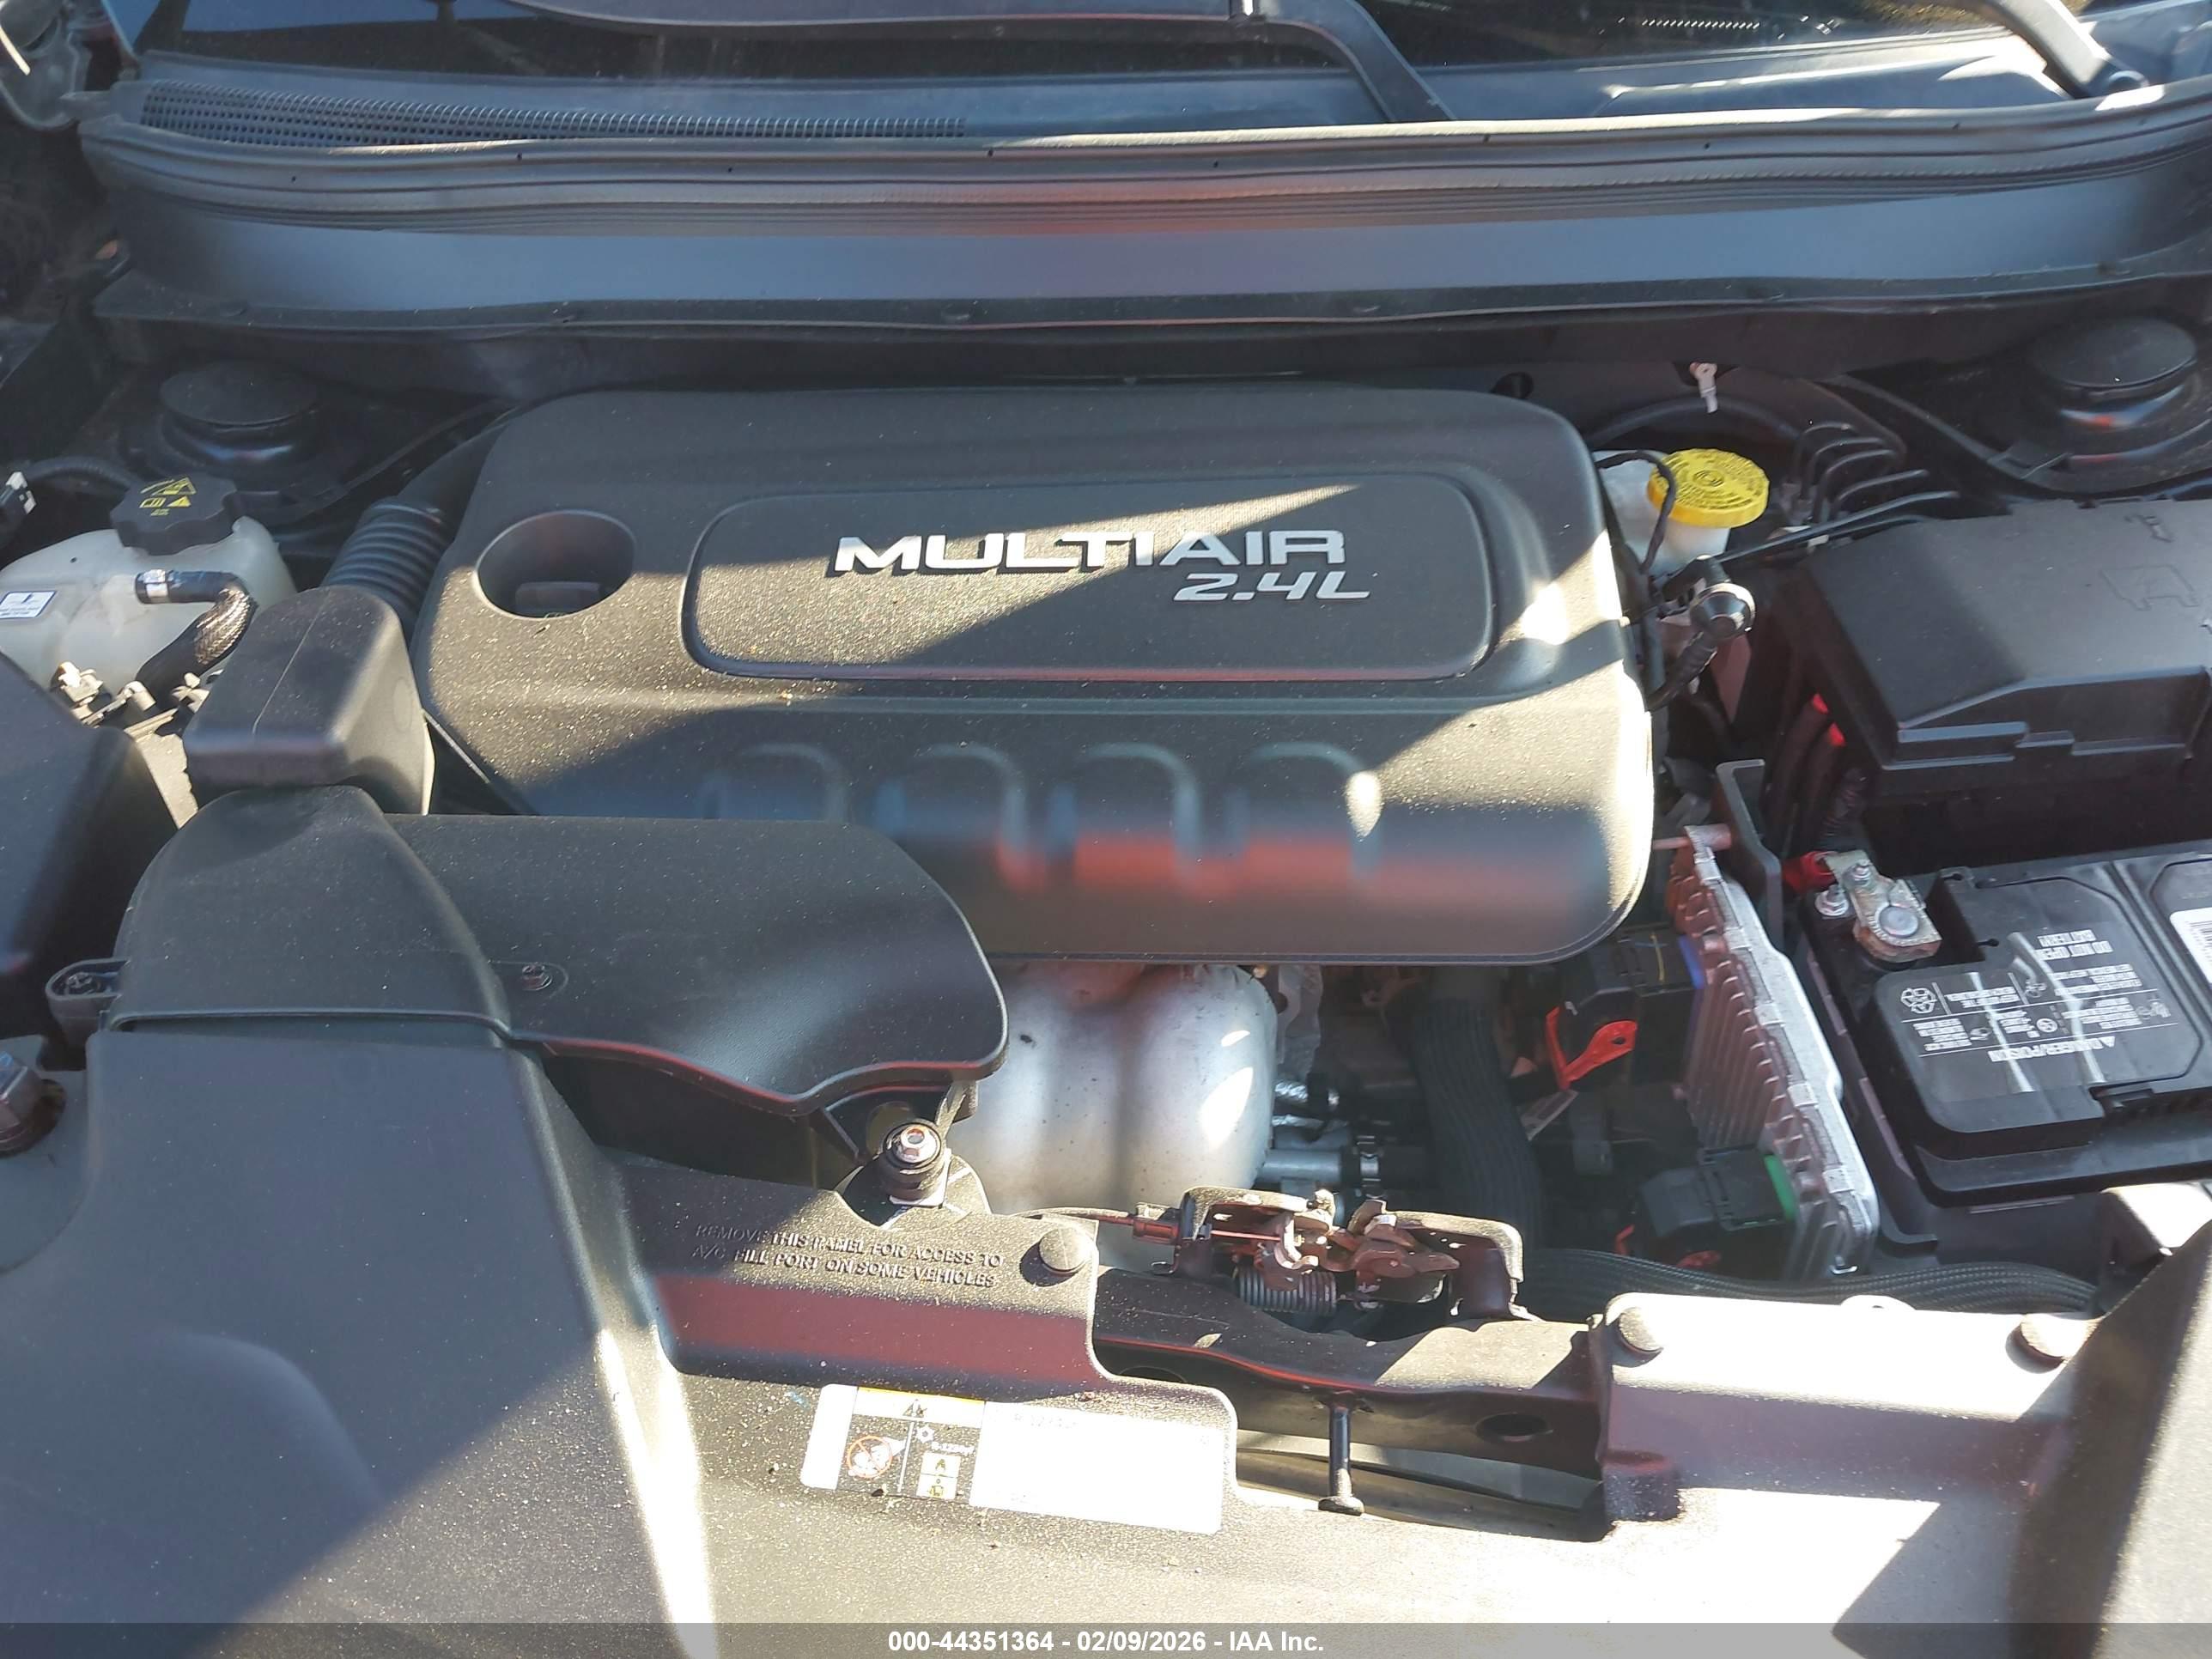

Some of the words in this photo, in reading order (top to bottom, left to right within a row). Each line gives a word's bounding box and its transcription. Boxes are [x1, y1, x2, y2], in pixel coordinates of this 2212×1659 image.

[833, 530, 1346, 573] MULTIAIR
[1173, 570, 1370, 602] 2.4L
[691, 1244, 726, 1261] A/C
[732, 1248, 769, 1266] FILL
[773, 1252, 821, 1271] PORT
[824, 1259, 854, 1274] ON
[855, 1261, 908, 1279] SOME
[913, 1267, 998, 1287] VEHICLES
[696, 1224, 769, 1244] REMOVE
[772, 1231, 809, 1249] THIS
[811, 1237, 865, 1255] PANEL
[870, 1243, 907, 1259] FOR
[908, 1247, 975, 1266] ACCESS
[980, 1253, 1004, 1268] TO
